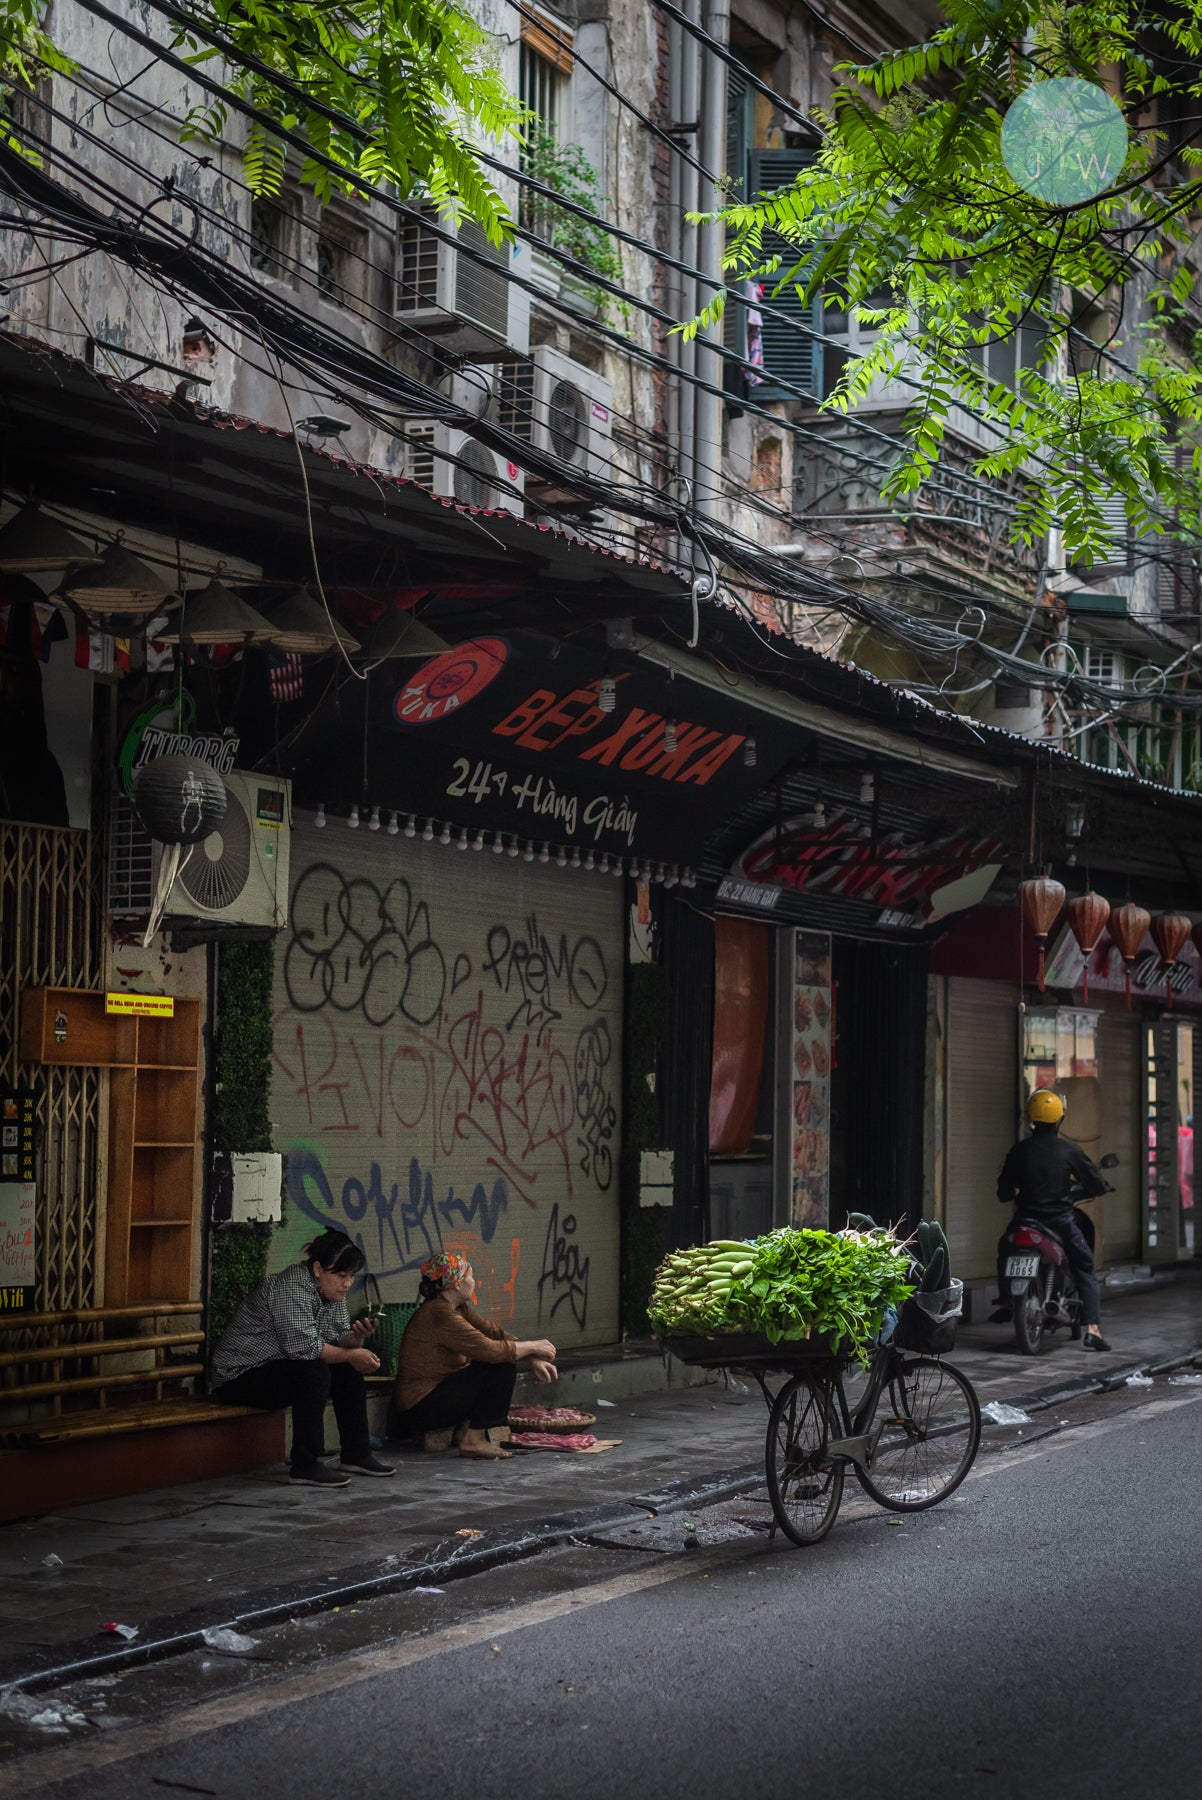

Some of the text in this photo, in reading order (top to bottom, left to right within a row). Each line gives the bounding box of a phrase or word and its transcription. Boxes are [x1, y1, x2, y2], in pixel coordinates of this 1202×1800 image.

[402, 684, 460, 720] XUKA
[136, 726, 240, 777] TUBORG
[577, 707, 747, 785] XUKA
[511, 769, 578, 835] Hàng
